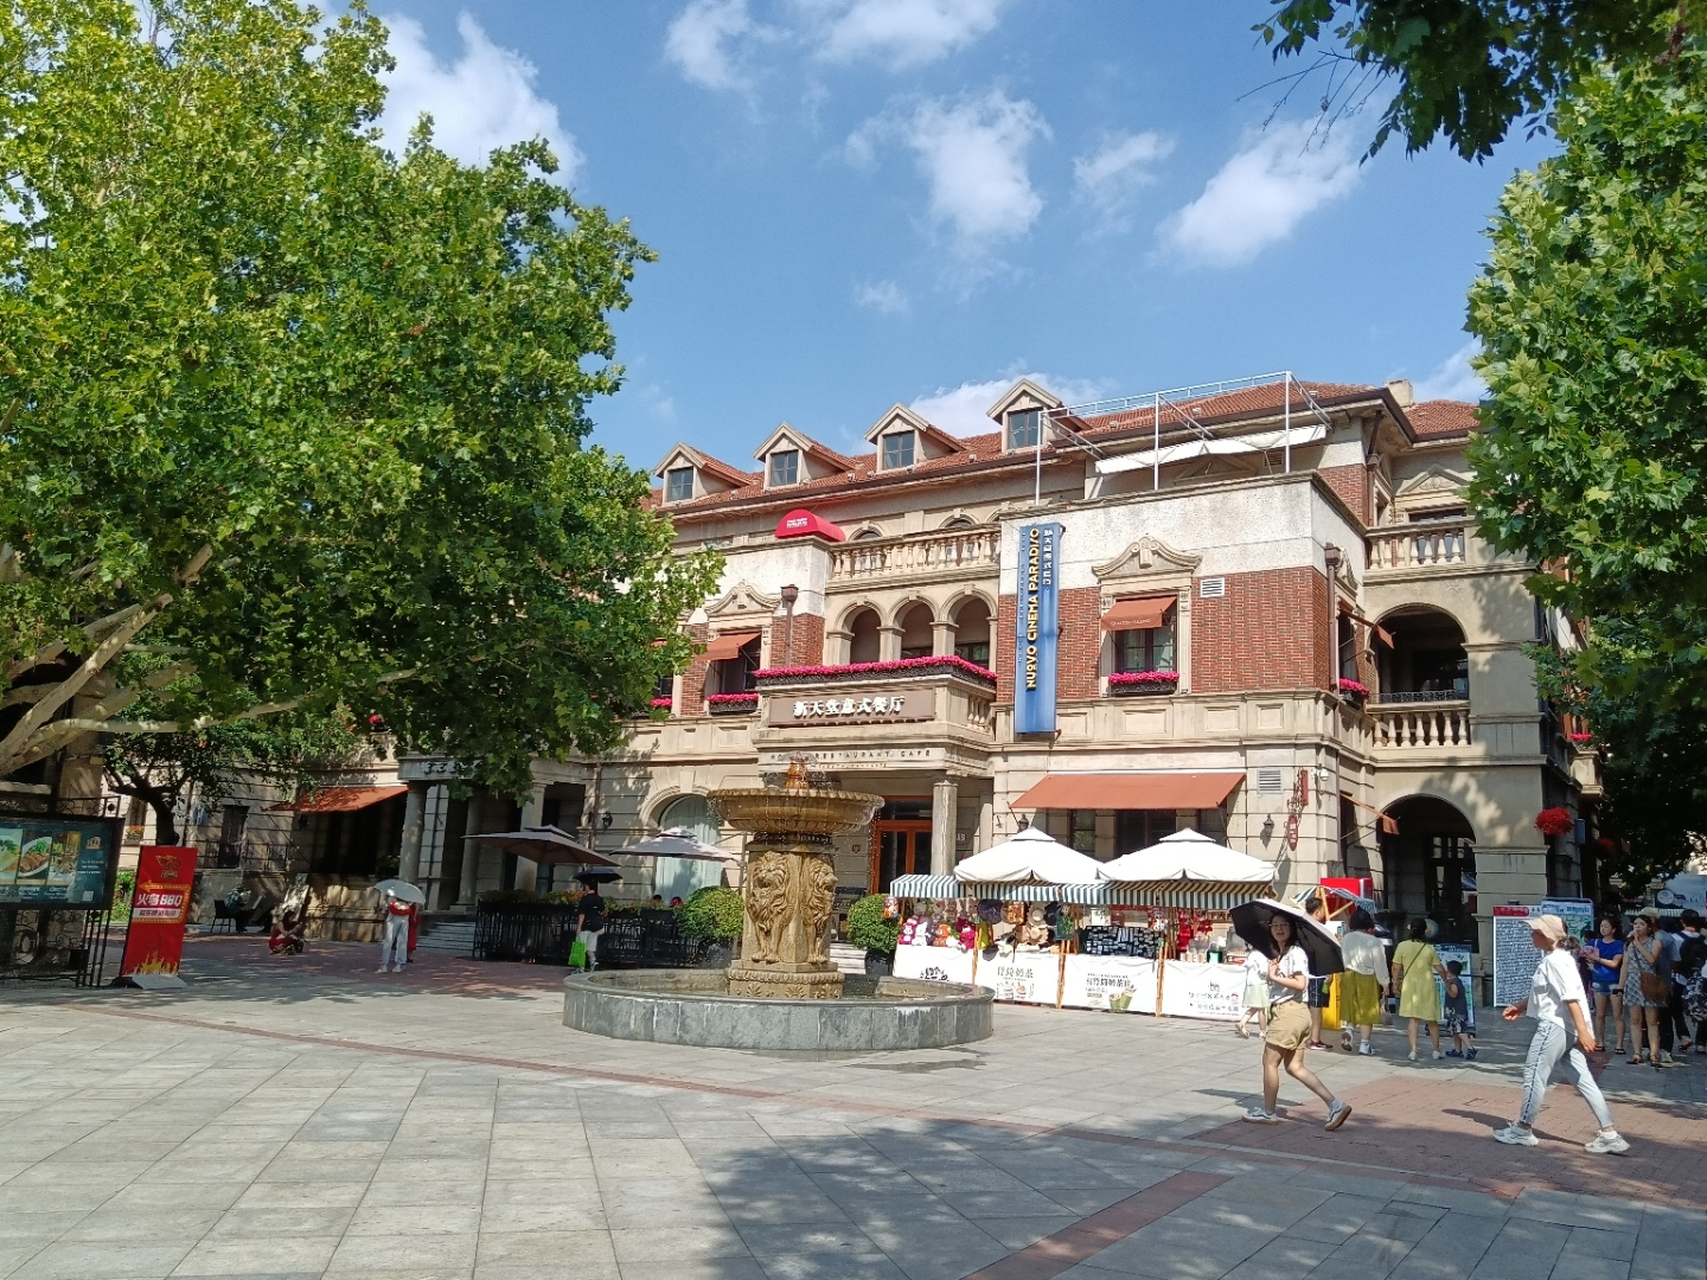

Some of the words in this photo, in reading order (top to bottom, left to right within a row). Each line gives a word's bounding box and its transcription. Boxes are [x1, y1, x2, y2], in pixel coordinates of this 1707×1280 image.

[1027, 595, 1039, 641] CINEMA
[793, 695, 905, 717] 新天堂意式餐厅
[160, 894, 183, 907] BBQ
